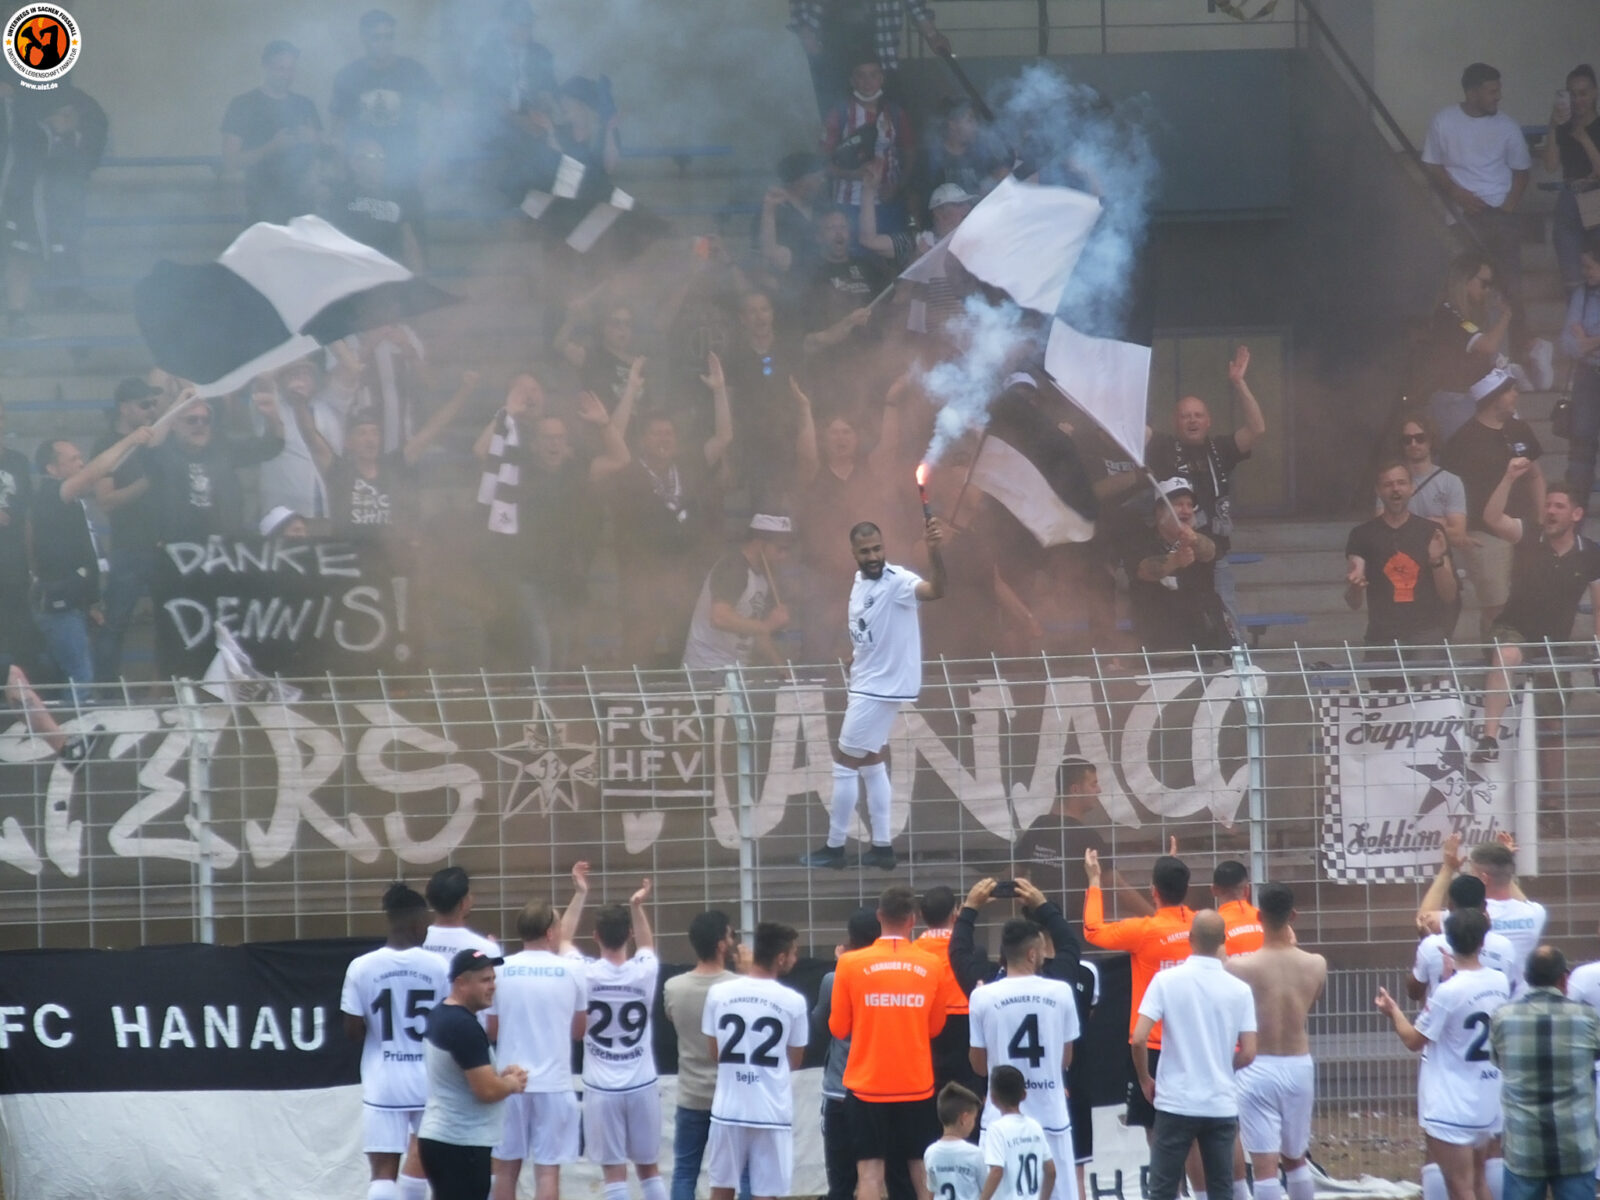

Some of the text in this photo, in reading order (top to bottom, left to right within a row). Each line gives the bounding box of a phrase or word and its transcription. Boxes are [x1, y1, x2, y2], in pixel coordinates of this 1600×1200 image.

[165, 534, 362, 578] DANKE
[163, 576, 410, 662] DENNIS!
[606, 705, 701, 743] FCK
[607, 749, 701, 784] HFV
[370, 988, 436, 1043] 15
[864, 992, 925, 1008] IGENICO
[0, 1003, 326, 1051] FC HANAU
[587, 1000, 648, 1049] 29
[718, 1013, 783, 1068] 22
[1007, 1013, 1045, 1069] 4
[1016, 1152, 1038, 1196] 10
